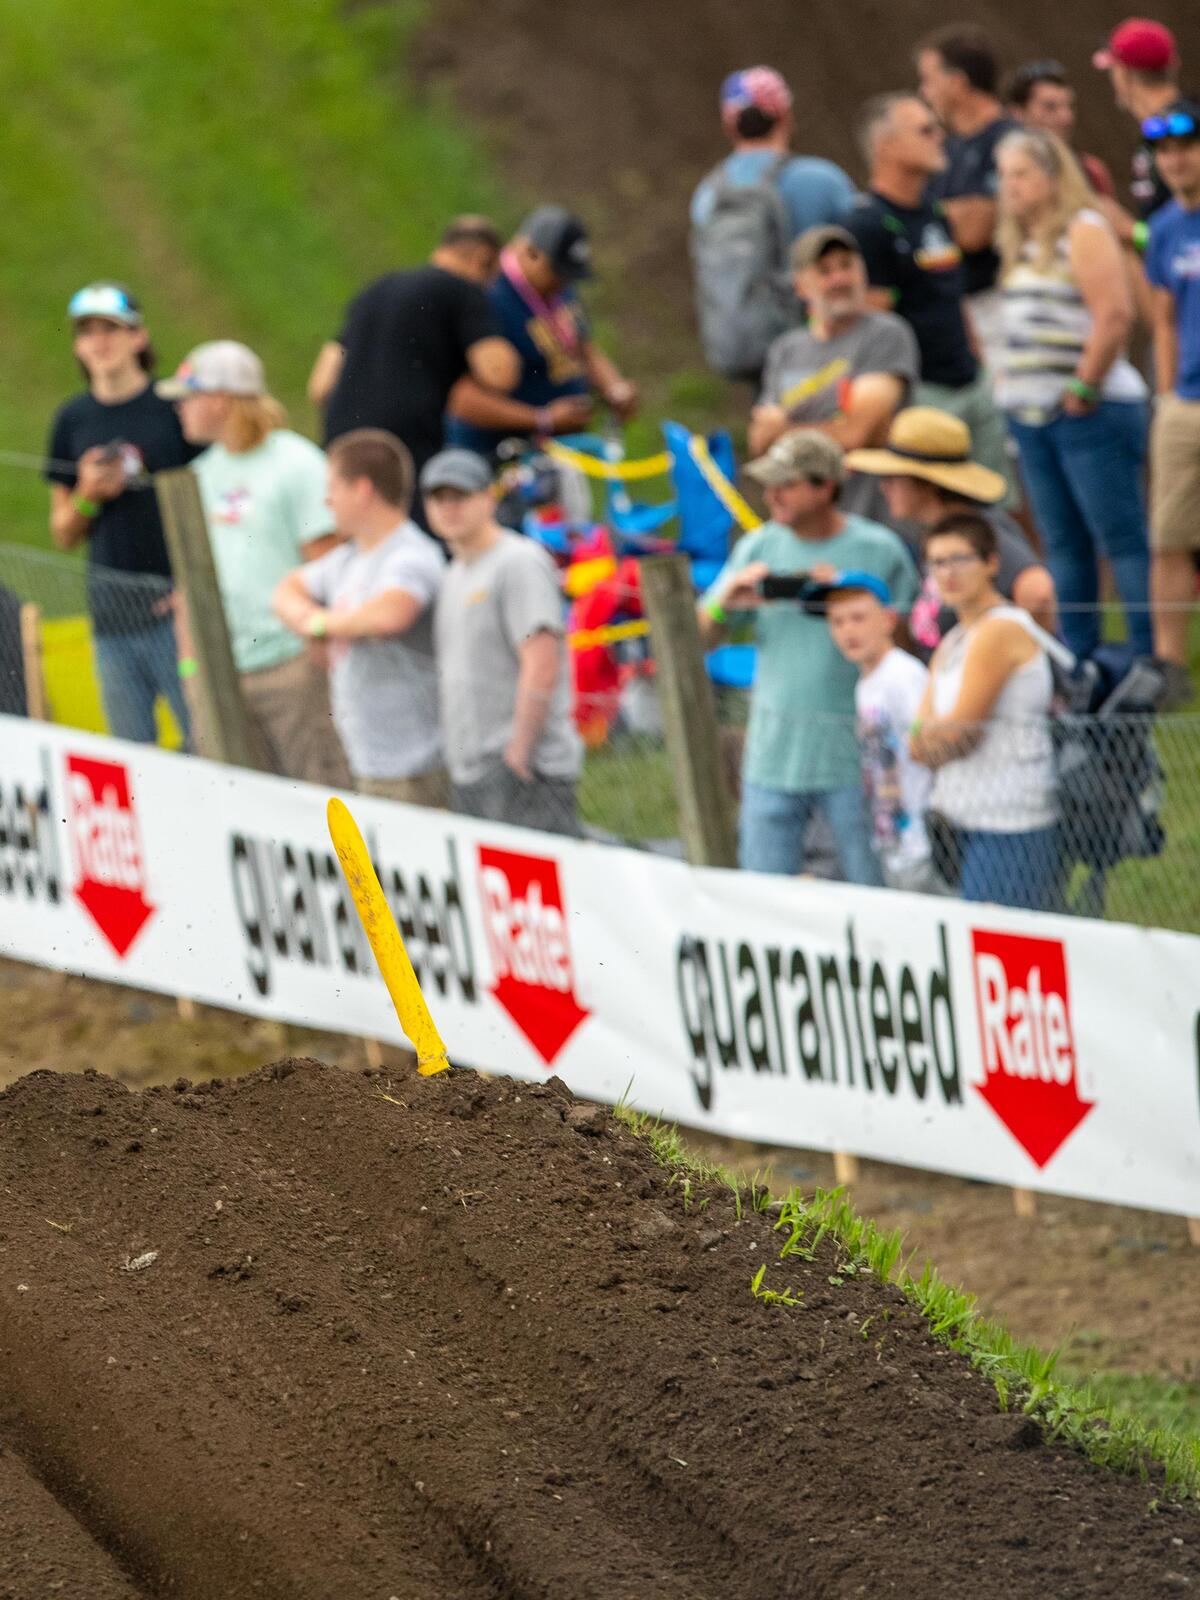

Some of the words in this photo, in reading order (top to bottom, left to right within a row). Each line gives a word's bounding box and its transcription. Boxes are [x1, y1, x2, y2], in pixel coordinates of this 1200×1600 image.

[230, 826, 477, 1002] guaraeed
[481, 866, 573, 994] Rate
[676, 914, 962, 1112] guaranteed
[974, 950, 1073, 1087] Rate
